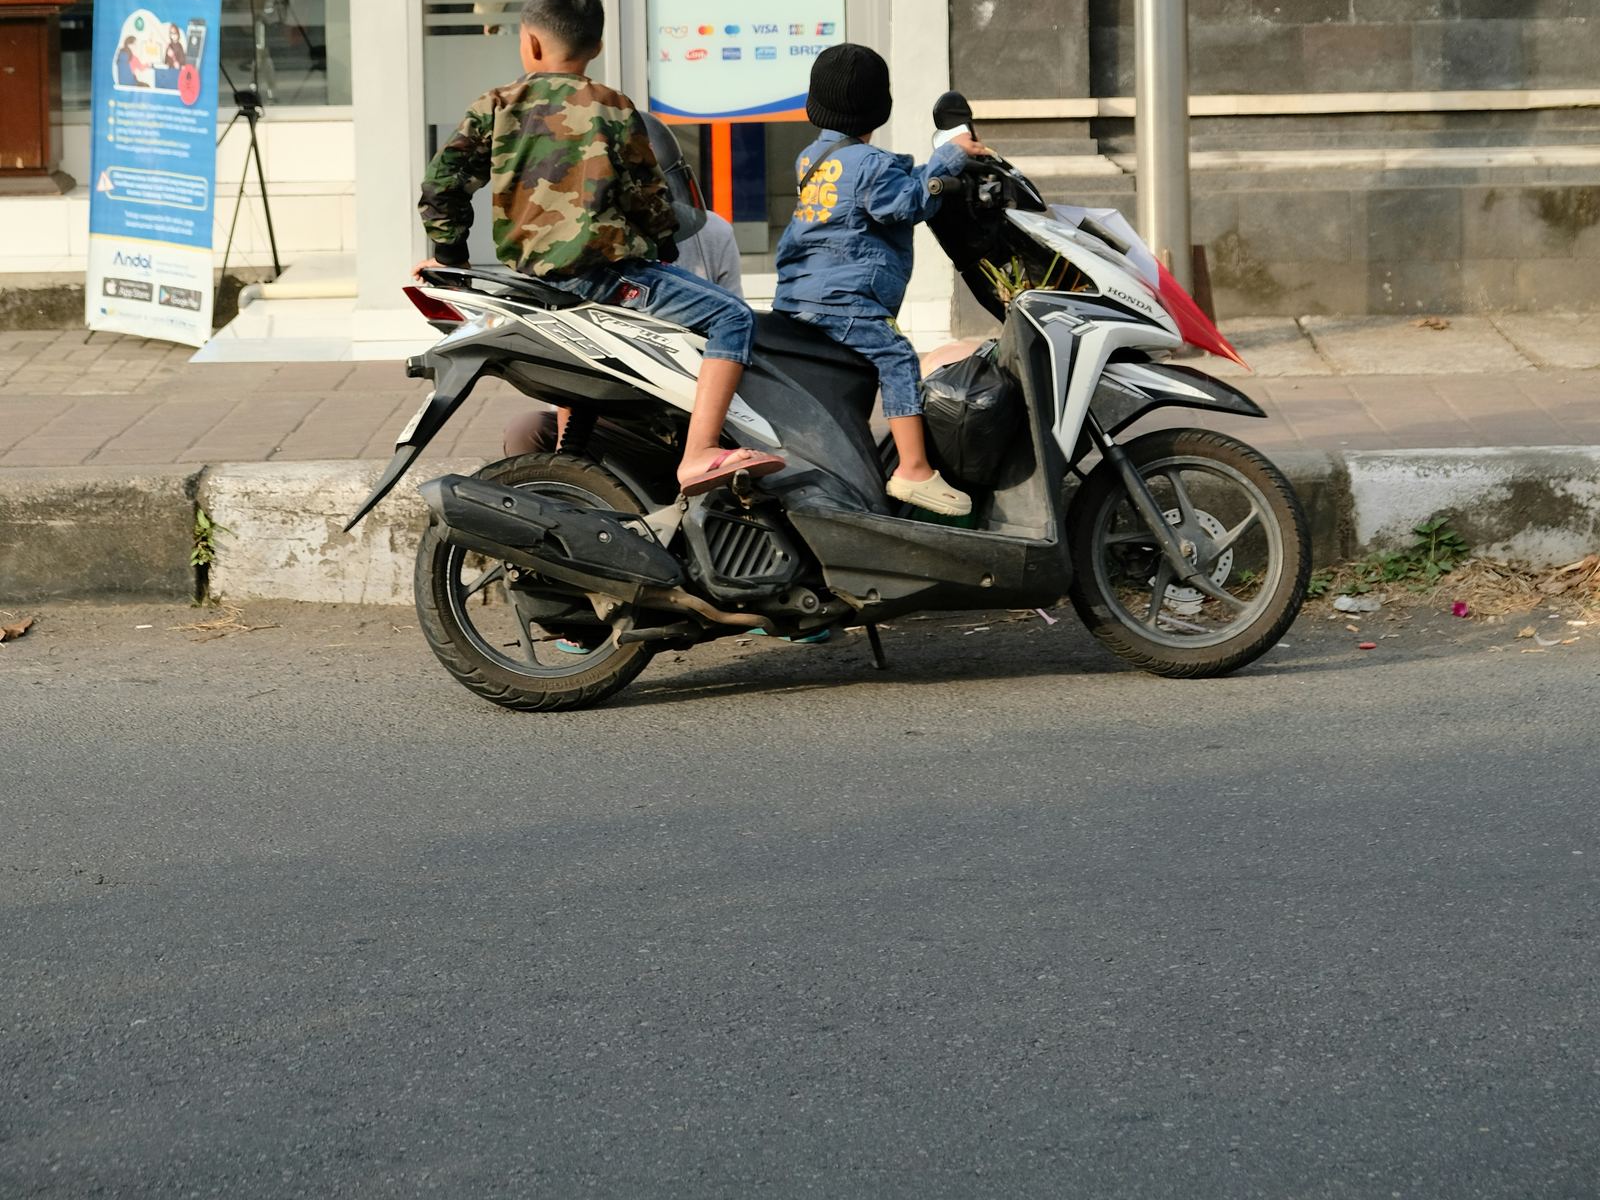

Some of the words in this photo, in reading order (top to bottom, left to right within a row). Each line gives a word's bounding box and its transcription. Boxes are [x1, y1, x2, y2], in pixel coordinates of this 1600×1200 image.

[752, 24, 779, 35] VISA
[1108, 286, 1154, 314] HONDA
[523, 312, 614, 360] 125
